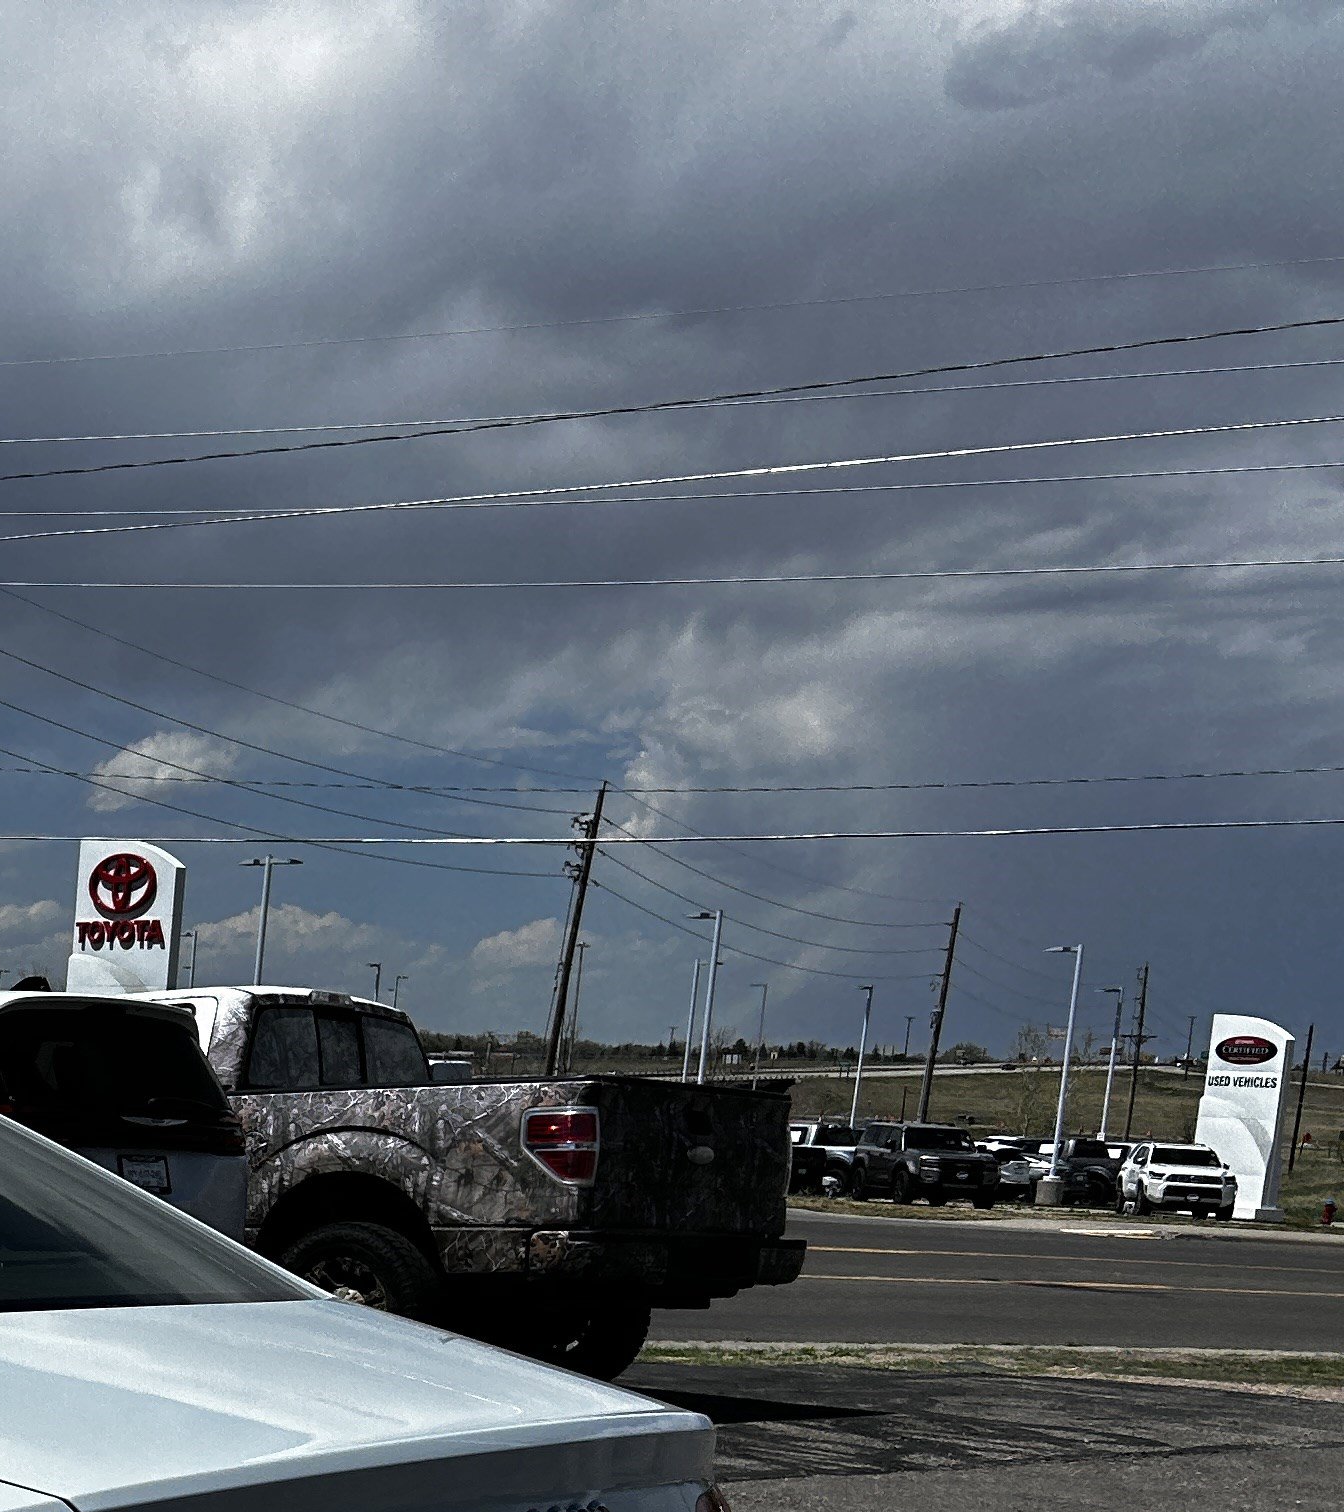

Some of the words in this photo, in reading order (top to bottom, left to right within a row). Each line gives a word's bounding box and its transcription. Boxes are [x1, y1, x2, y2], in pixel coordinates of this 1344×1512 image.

[76, 920, 165, 950] TOYOTA
[1208, 1075, 1231, 1087] USED
[1233, 1076, 1278, 1089] VEHICLES
